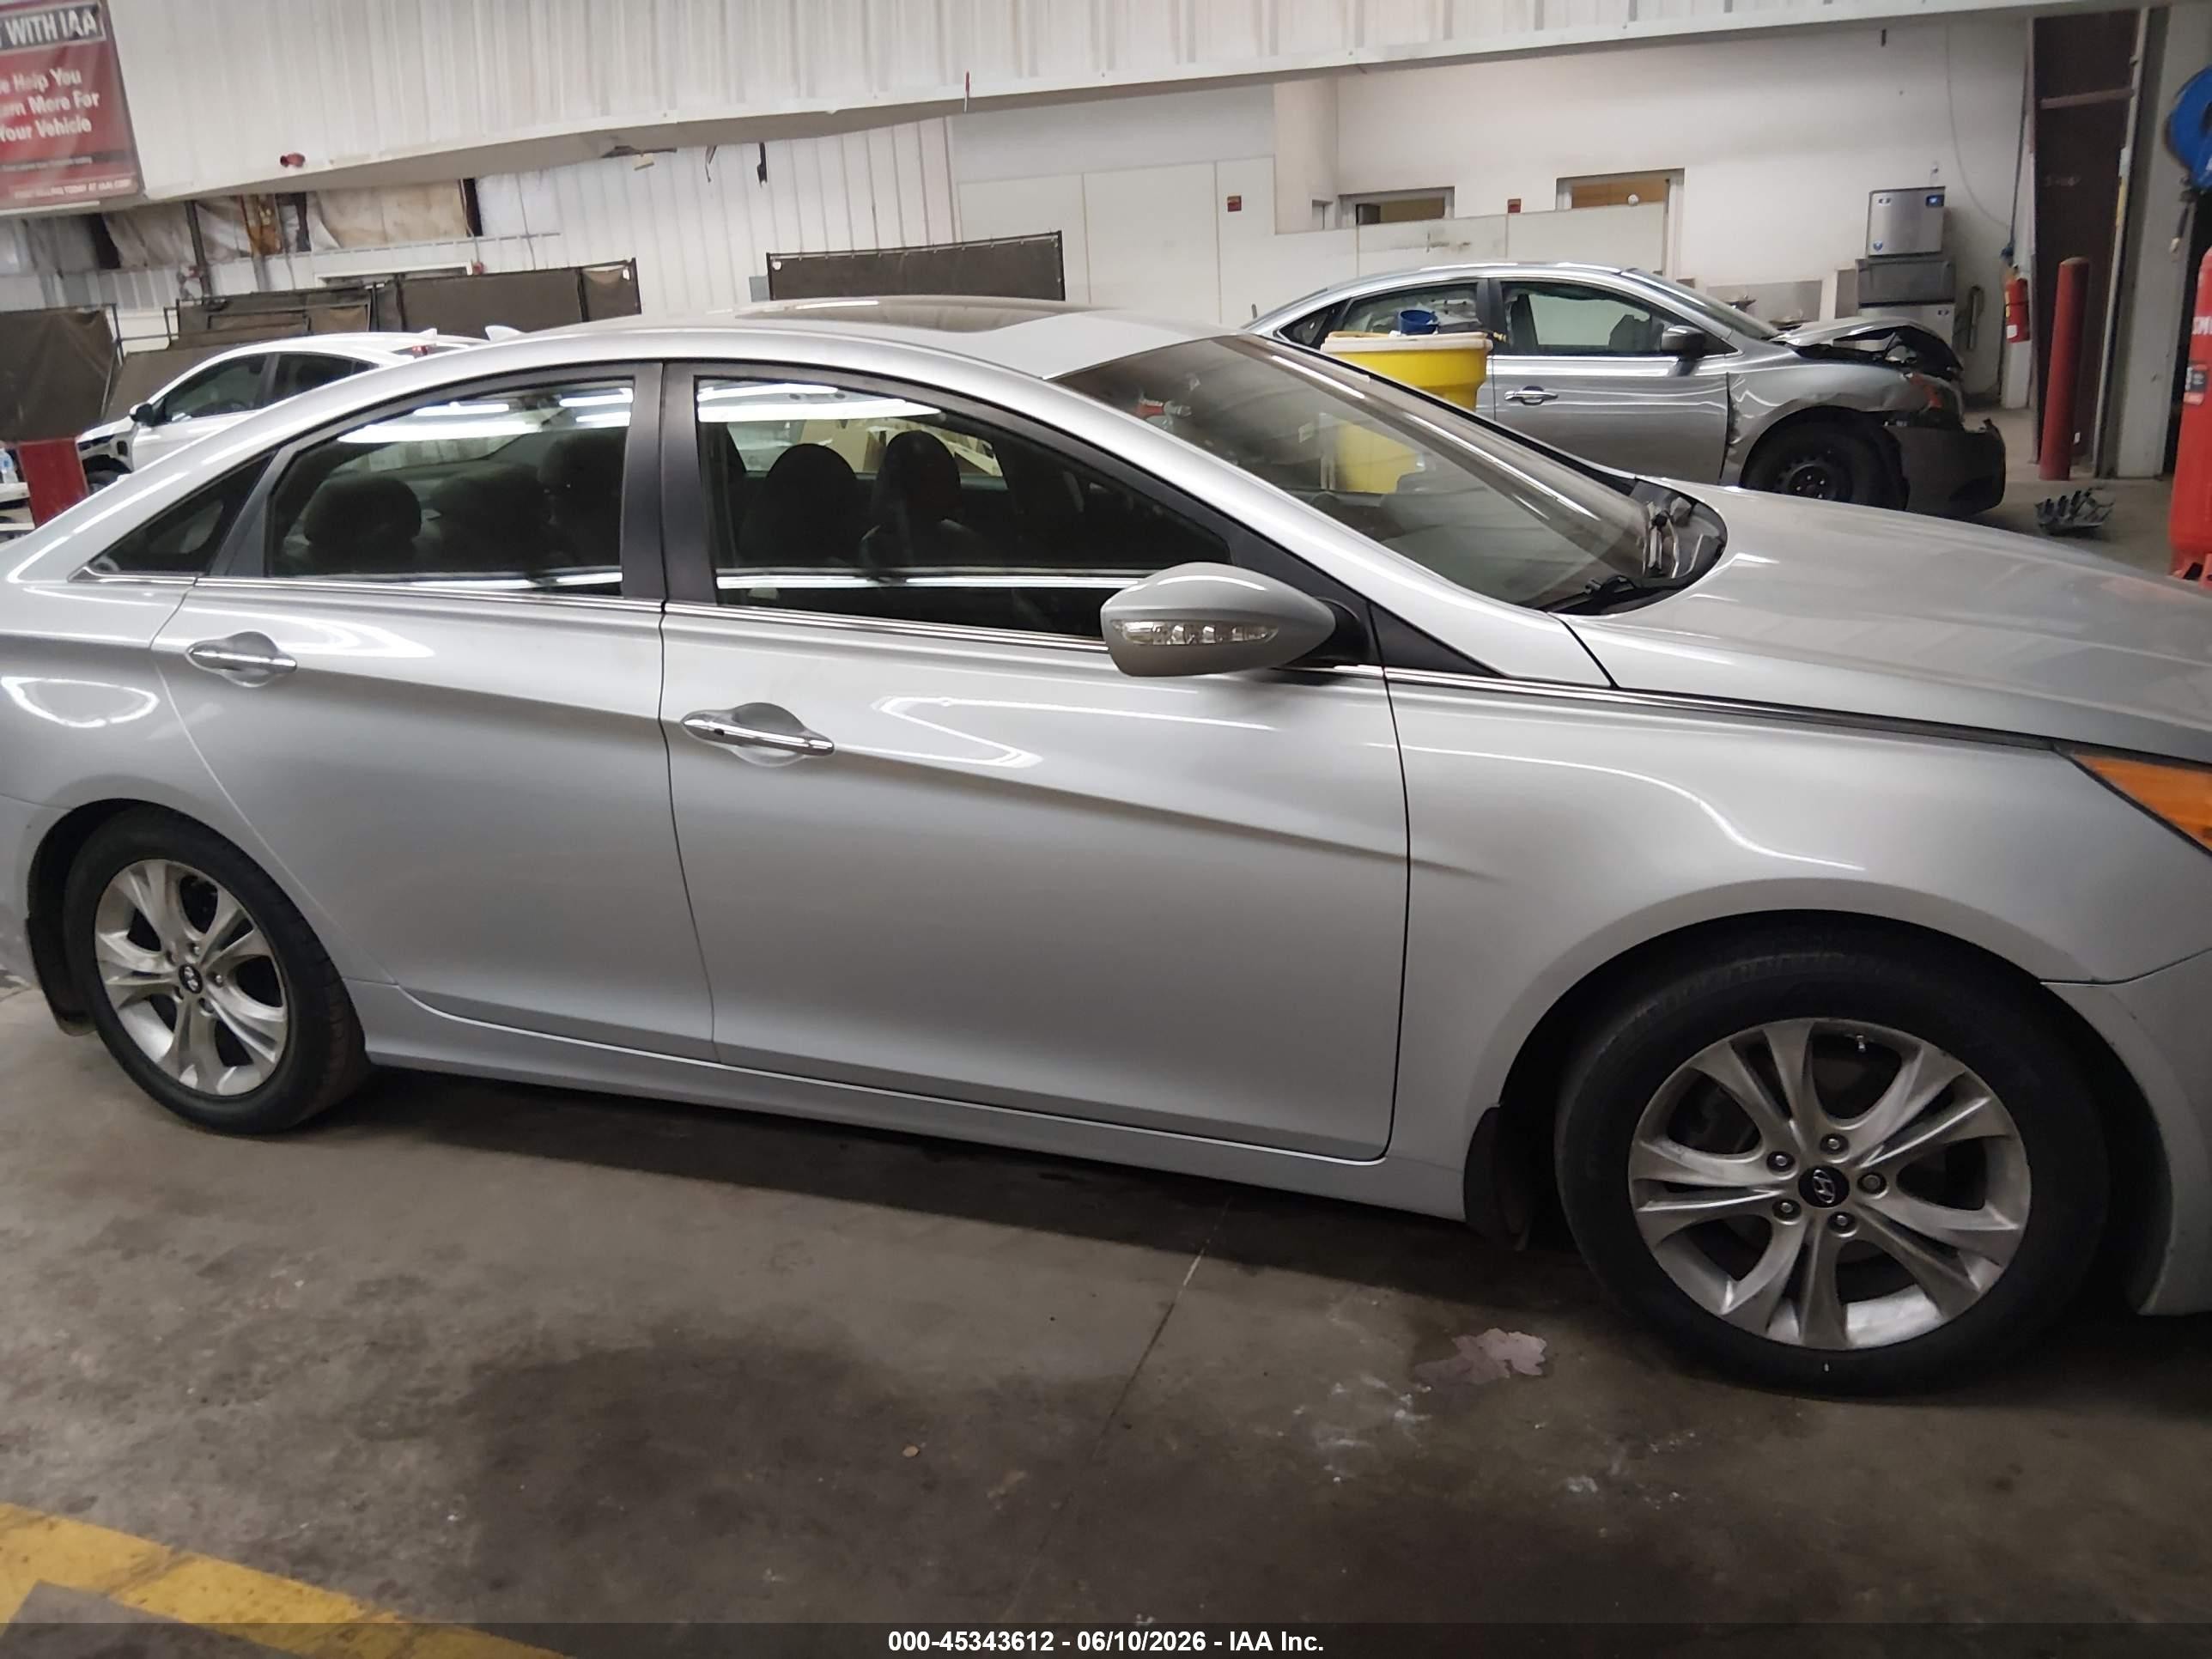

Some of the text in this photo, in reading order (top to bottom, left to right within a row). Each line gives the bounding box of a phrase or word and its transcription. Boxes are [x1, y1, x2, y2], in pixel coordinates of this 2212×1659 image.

[5, 13, 58, 45] WITH
[59, 9, 97, 38] IAA
[12, 71, 49, 94] Help
[49, 67, 82, 87] You
[27, 94, 70, 114] More
[72, 89, 100, 109] For
[34, 114, 93, 138] Vehicle
